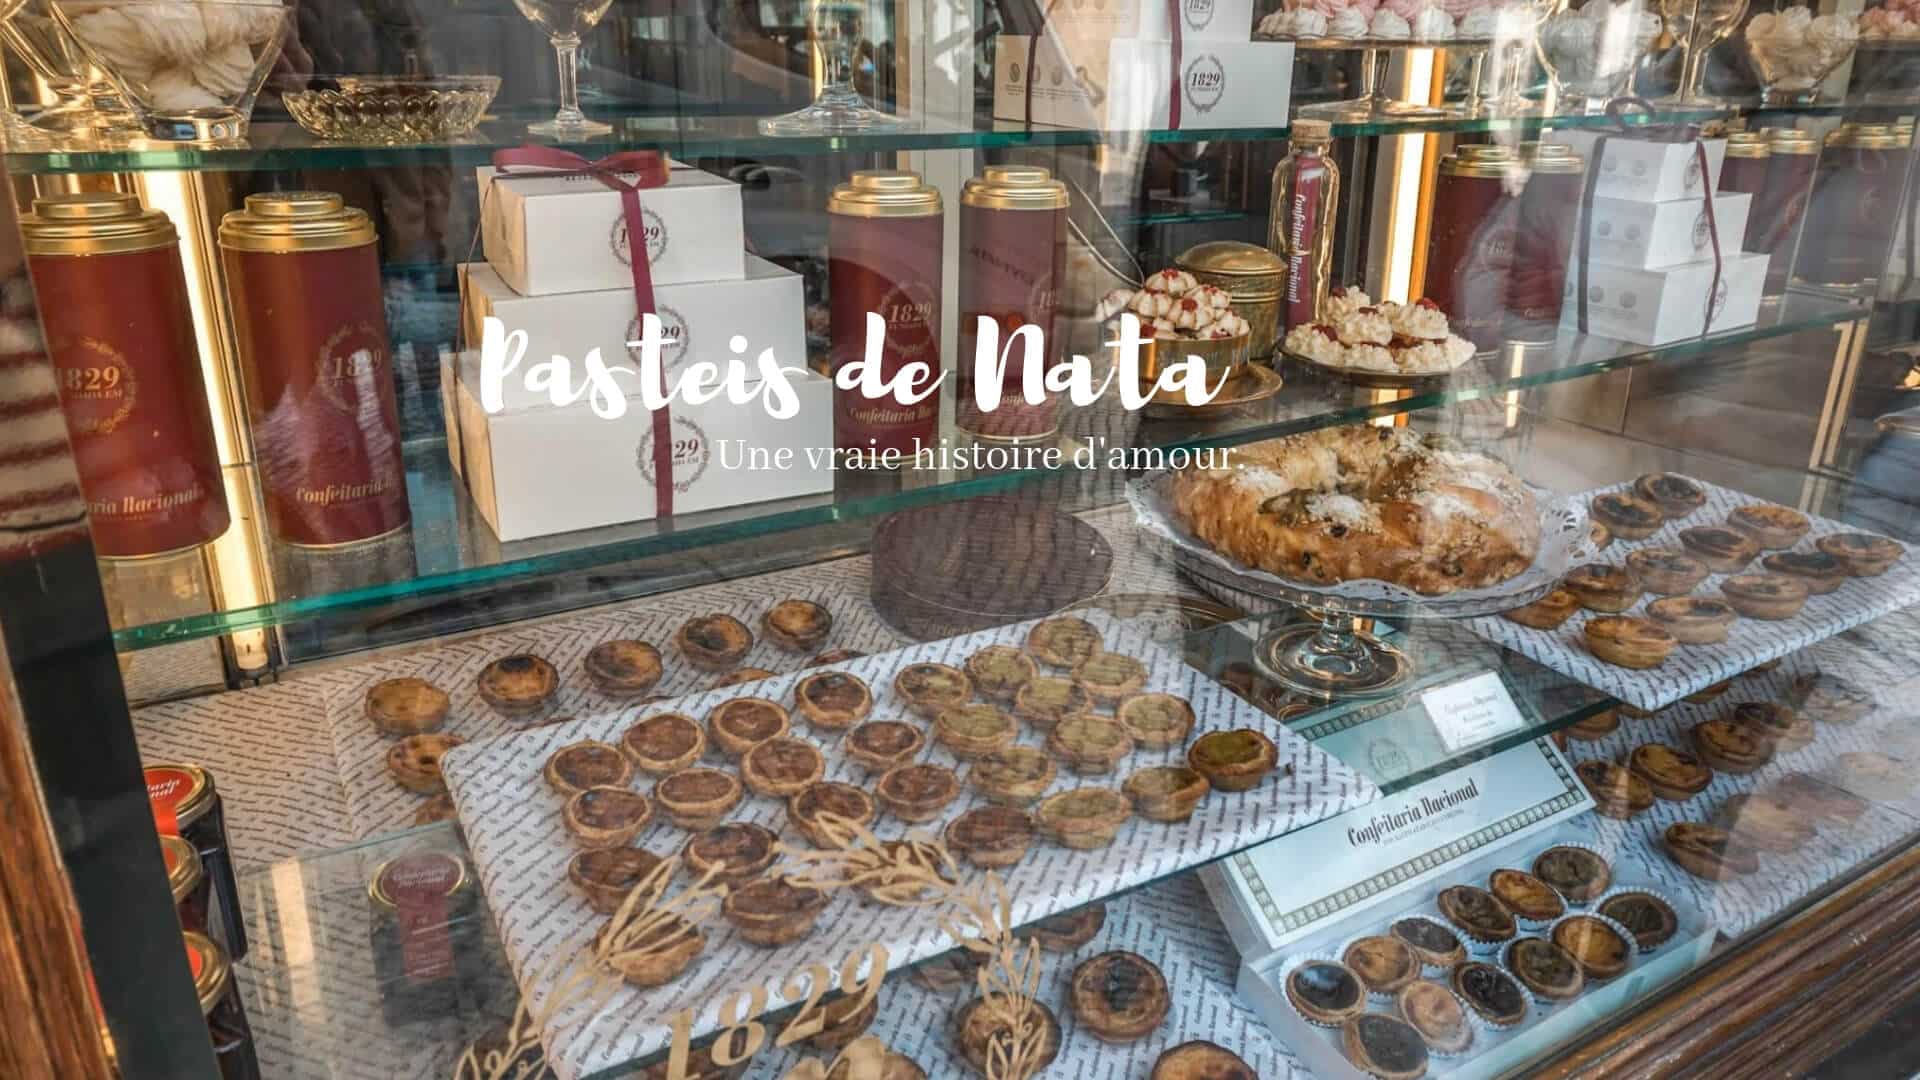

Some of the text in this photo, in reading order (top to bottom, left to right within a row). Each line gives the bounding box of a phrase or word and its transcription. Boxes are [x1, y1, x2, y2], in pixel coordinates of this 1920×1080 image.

[1191, 72, 1220, 87] 1829
[619, 226, 660, 244] 129
[123, 483, 199, 514] Nacional
[296, 479, 382, 506] Confeitaria
[1347, 804, 1422, 847] Confeitaria
[1420, 777, 1479, 816] Nacional
[666, 942, 889, 1080] 1829
